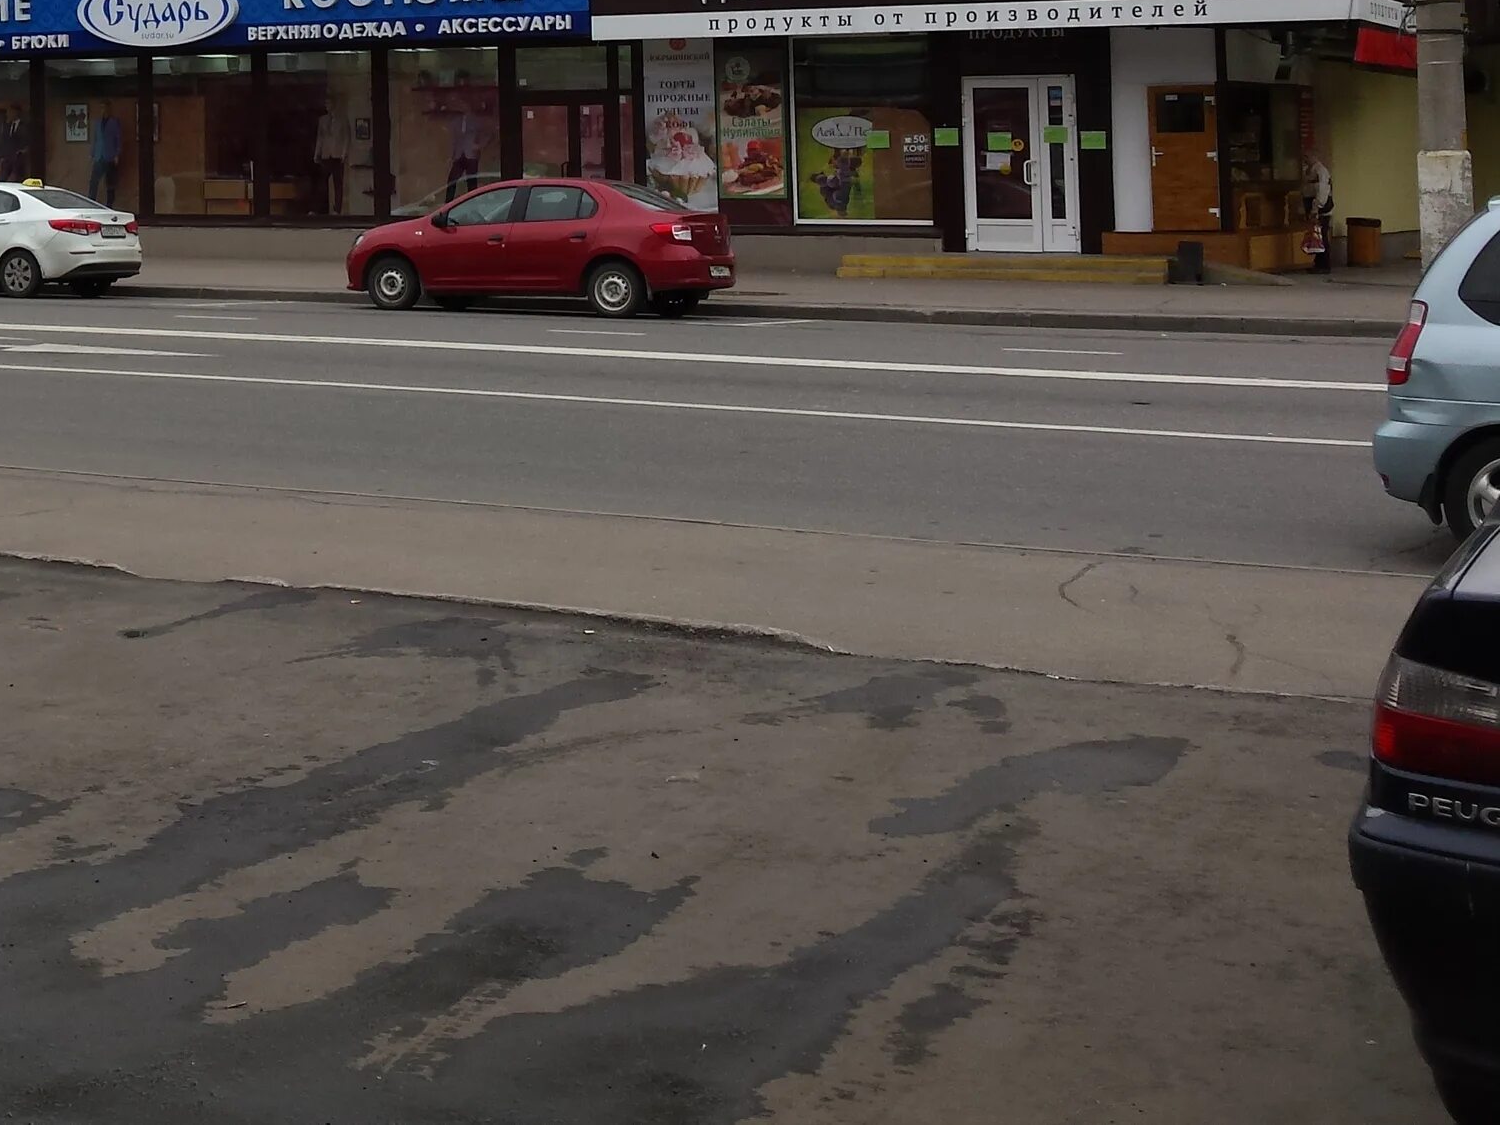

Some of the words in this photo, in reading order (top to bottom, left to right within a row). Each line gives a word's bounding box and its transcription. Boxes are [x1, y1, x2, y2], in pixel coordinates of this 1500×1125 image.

[708, 14, 853, 33] продукты
[874, 12, 903, 25] от
[925, 0, 1208, 26] производителей
[247, 25, 321, 41] ВЕРХНЯЯ
[323, 21, 407, 39] ОДЕЖДА
[438, 14, 572, 35] АКСЕССУАРЫ
[11, 34, 70, 50] БРЮКИ
[659, 80, 695, 89] ТОРТЫ
[647, 94, 710, 102] ПИРОЖНЫЕ
[1408, 792, 1500, 826] PEUG
